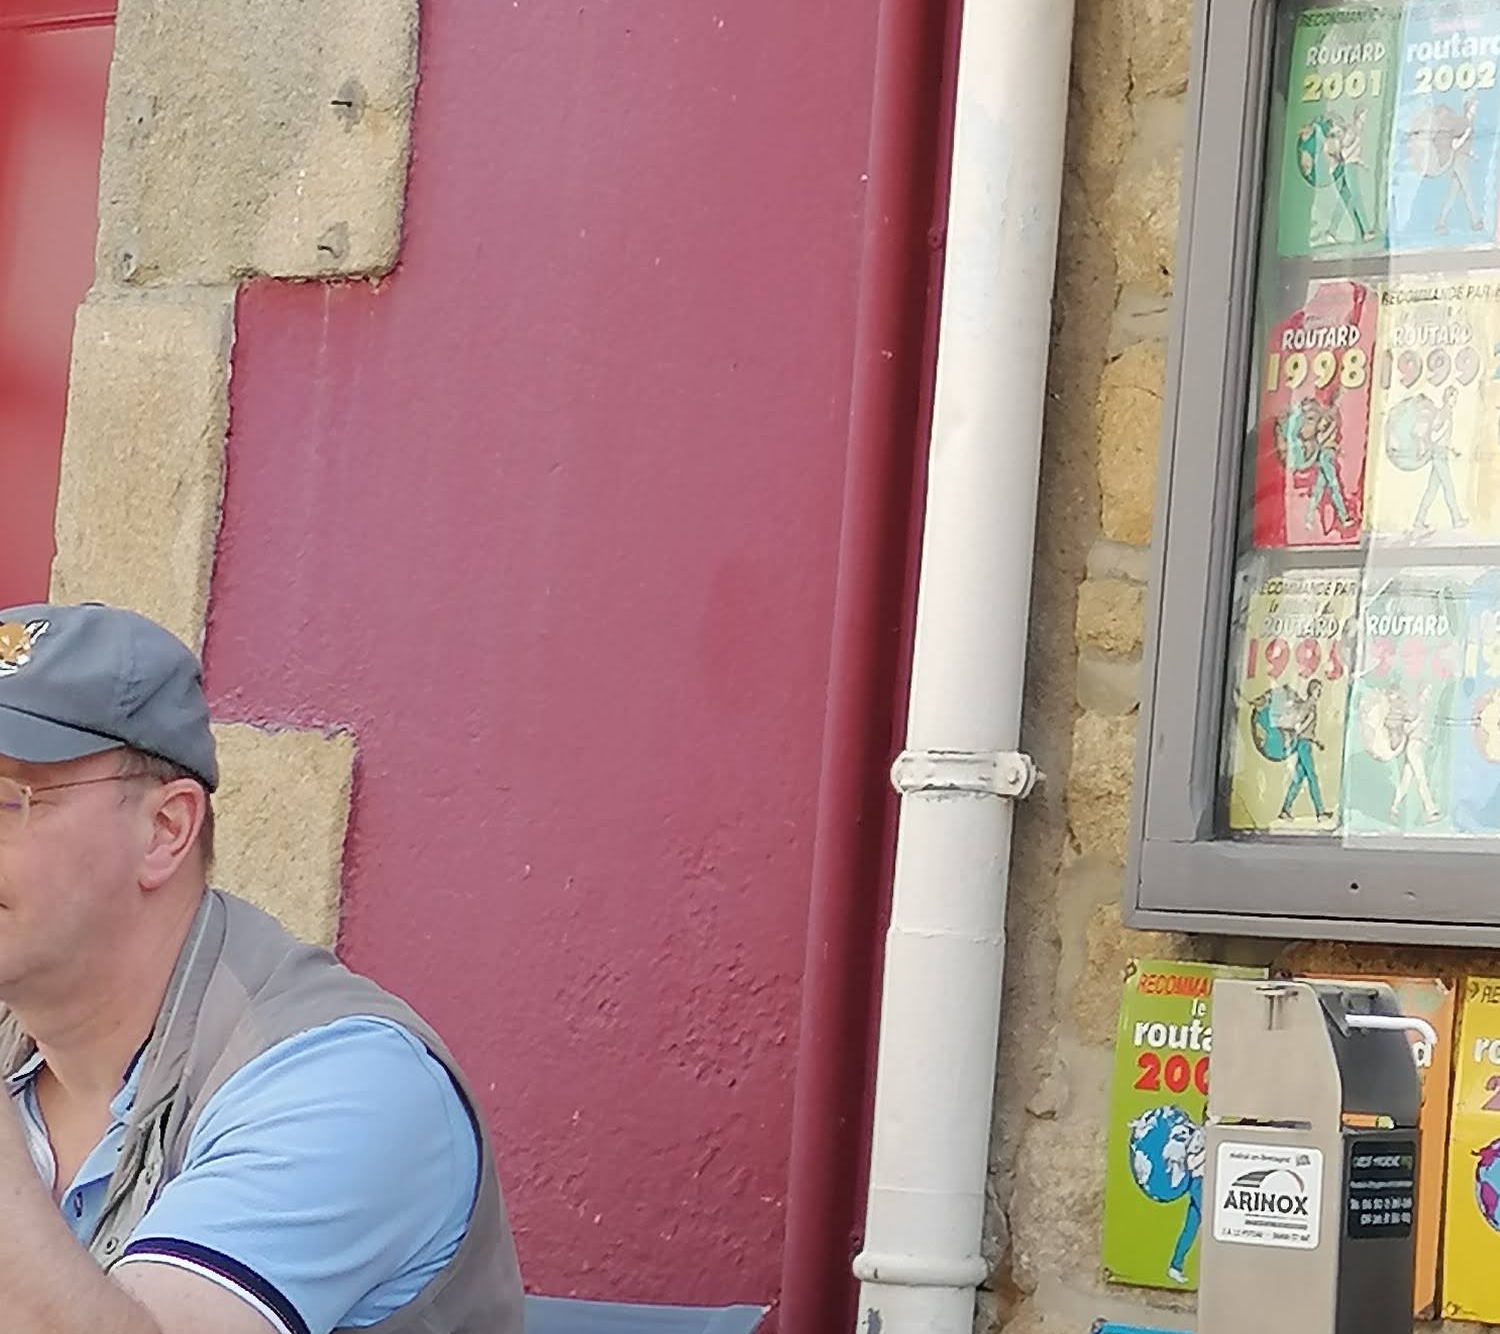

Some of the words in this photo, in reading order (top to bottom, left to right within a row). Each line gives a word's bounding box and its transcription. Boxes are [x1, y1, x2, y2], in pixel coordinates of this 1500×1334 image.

[1306, 42, 1386, 67] ROUTARD
[1302, 69, 1381, 103] 2001
[1415, 60, 1497, 94] 2002
[1282, 325, 1361, 351] ROUTARD
[1393, 324, 1473, 348] ROUTARD
[1267, 348, 1367, 393] 1998
[1380, 346, 1481, 390] 1999
[1260, 616, 1341, 639] ROUTARD
[1365, 614, 1449, 636] ROUTARD
[1191, 997, 1208, 1018] le
[1223, 1189, 1309, 1216] ARINOX
